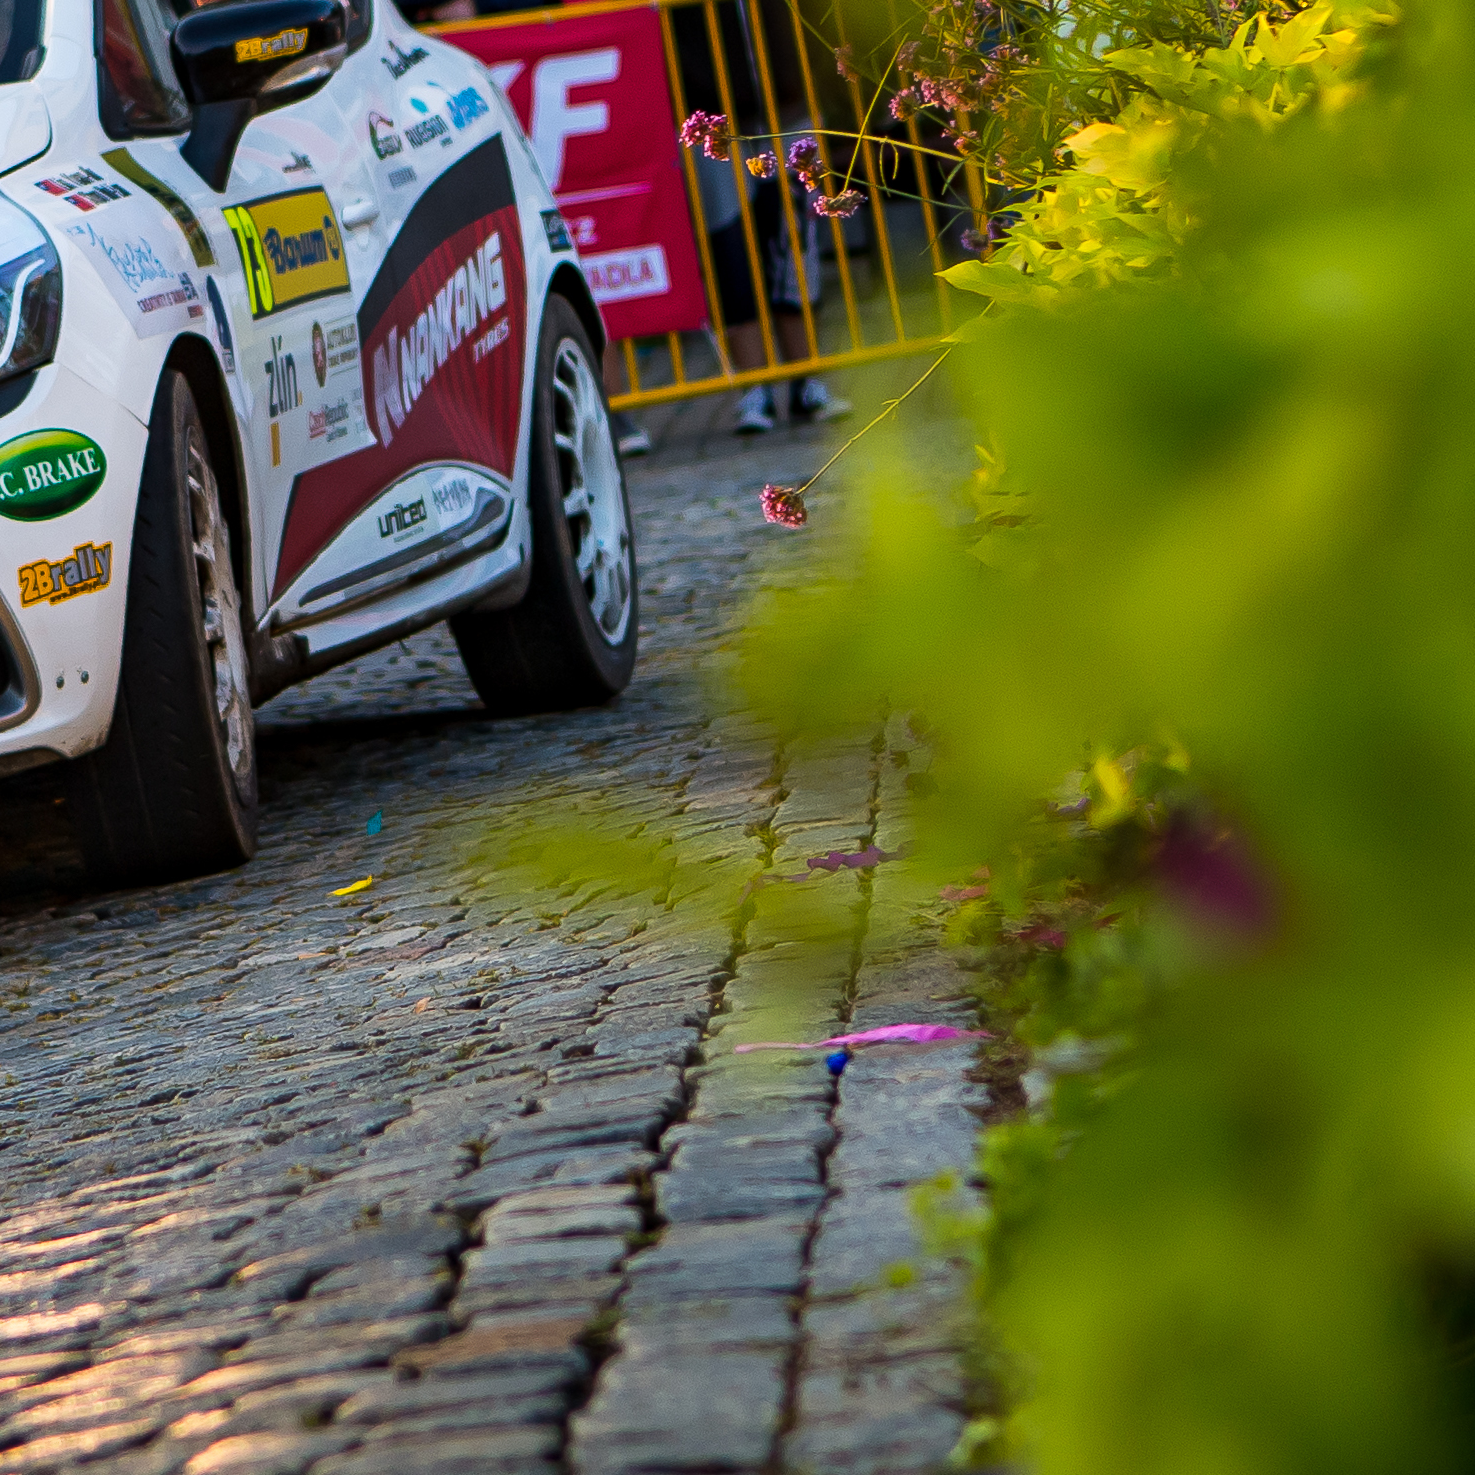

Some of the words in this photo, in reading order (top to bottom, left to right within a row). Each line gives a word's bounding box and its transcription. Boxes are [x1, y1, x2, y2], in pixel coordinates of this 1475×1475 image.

[223, 206, 274, 315] 73
[401, 230, 508, 413] NANKANG
[23, 447, 102, 493] BRAKE
[377, 494, 428, 539] united
[19, 542, 112, 605] 2Brally
